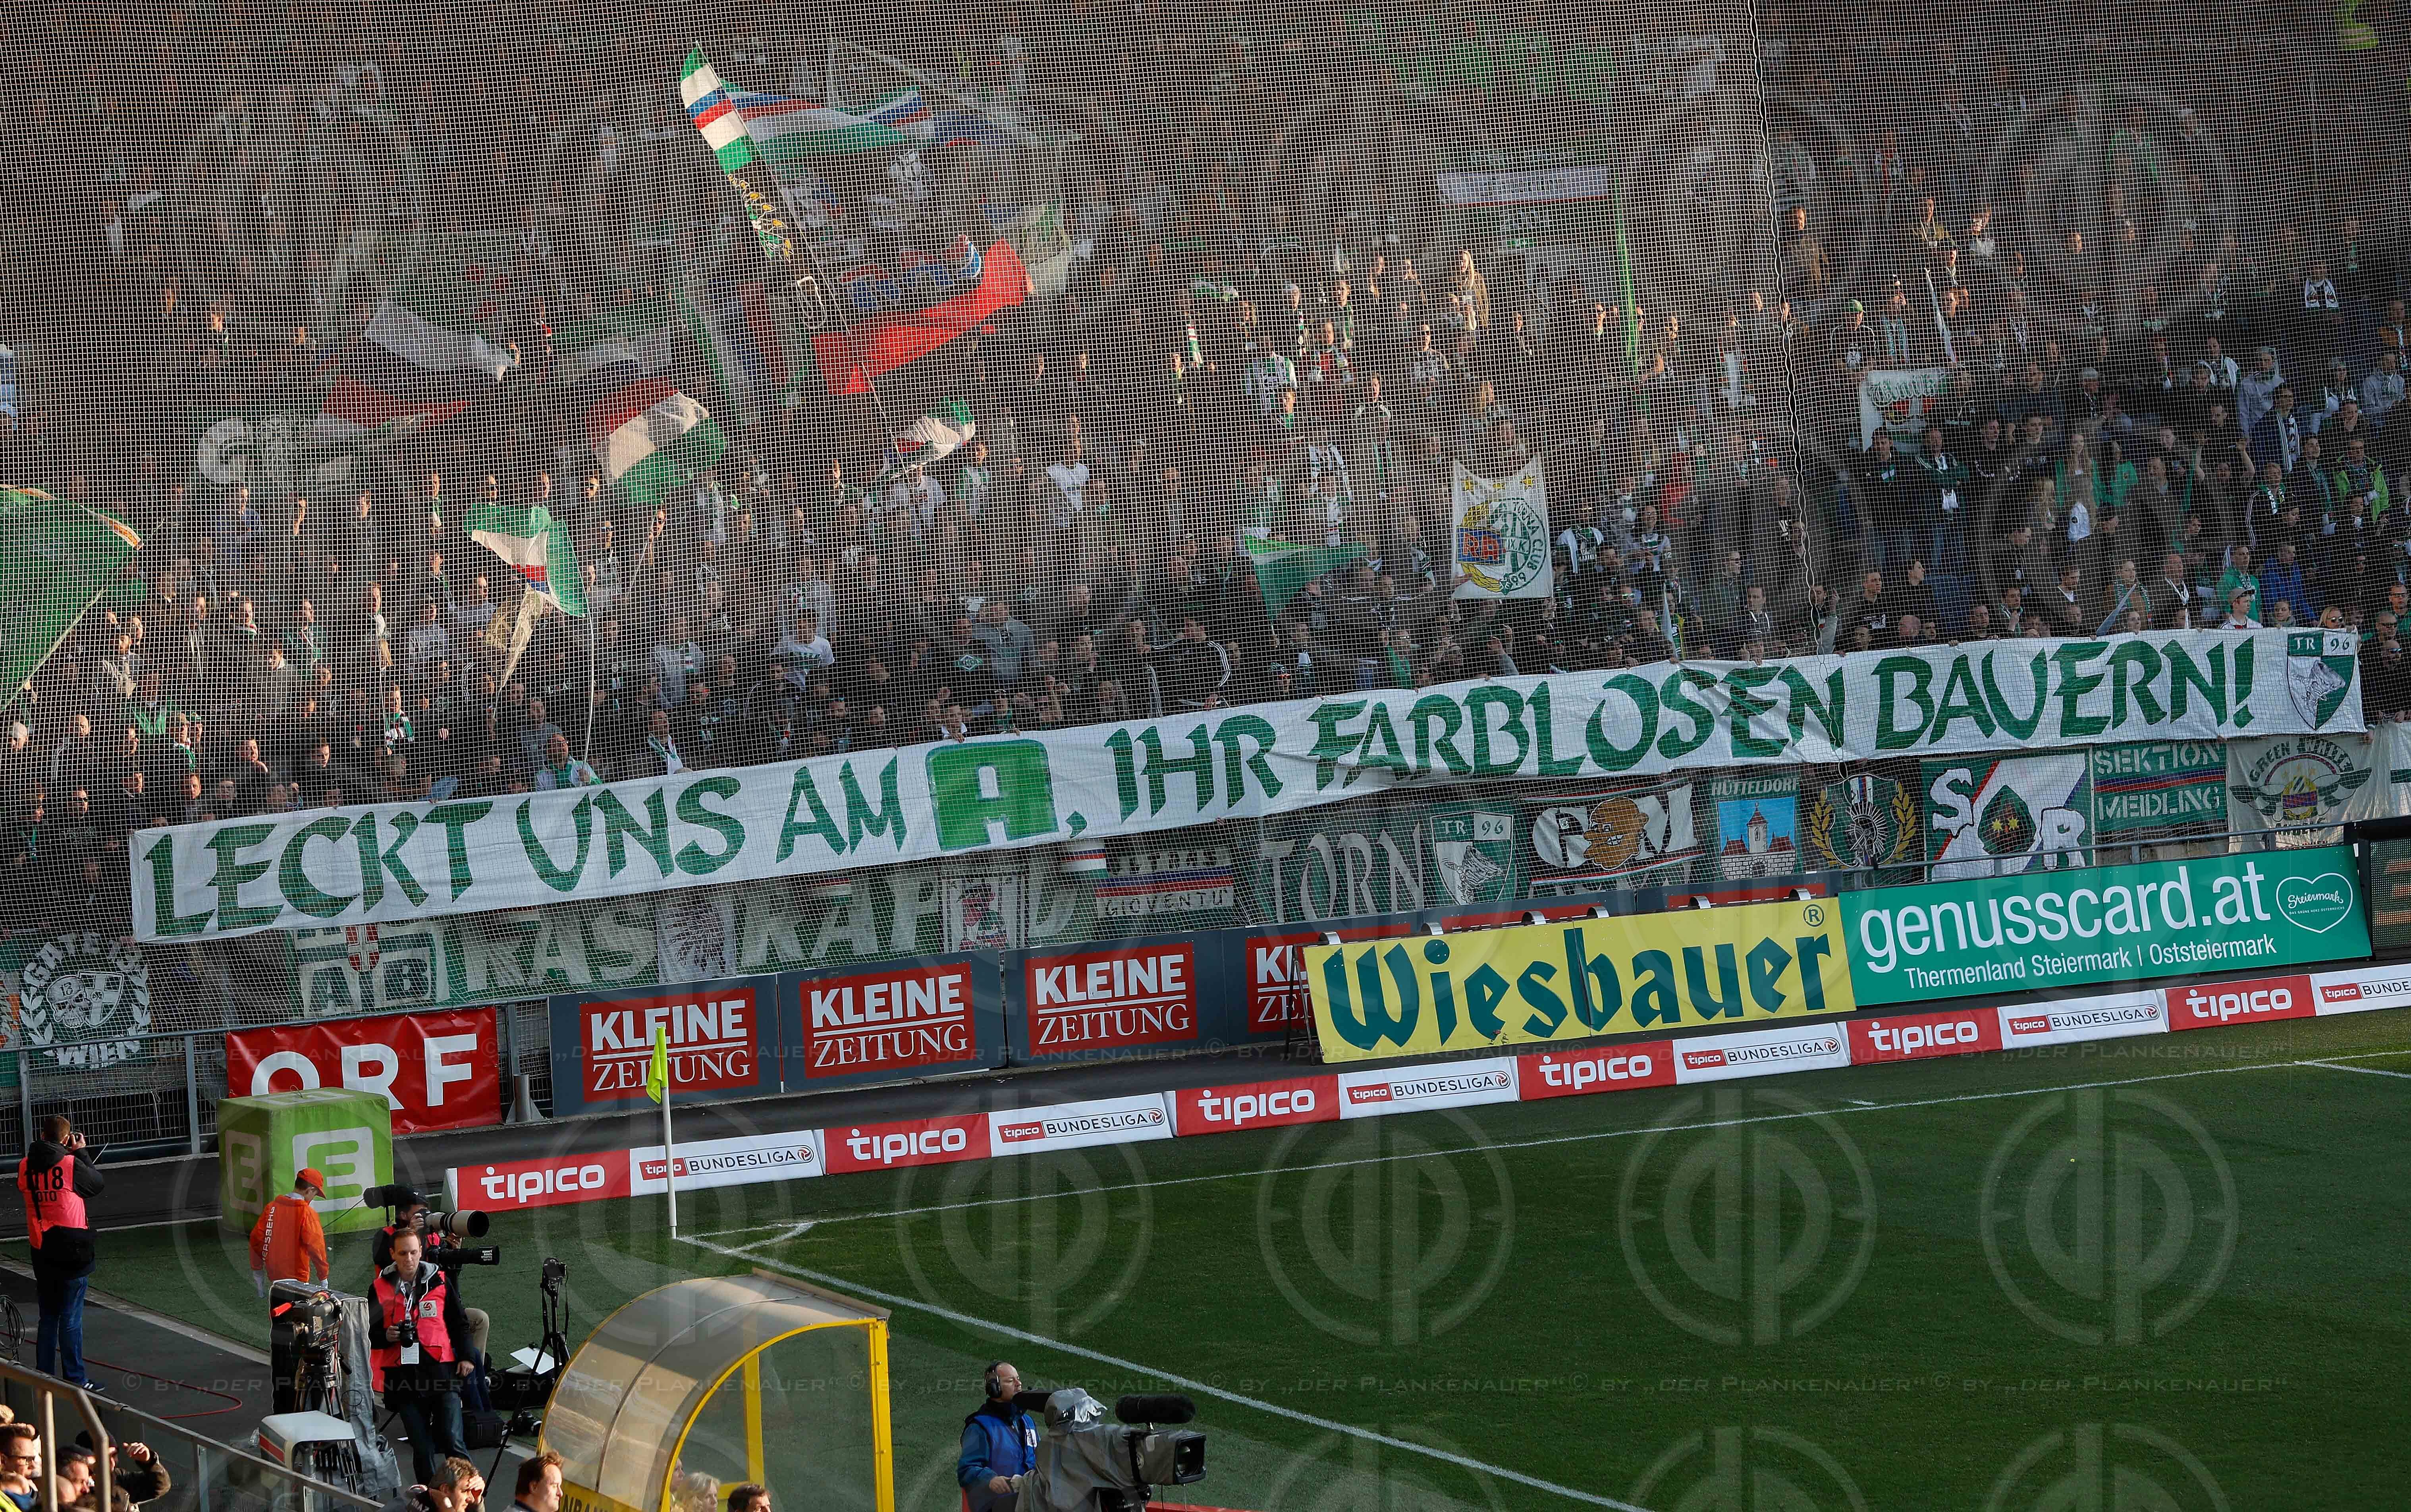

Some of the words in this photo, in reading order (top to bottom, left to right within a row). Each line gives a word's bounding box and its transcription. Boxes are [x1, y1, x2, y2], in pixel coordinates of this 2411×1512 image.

[2293, 638, 2315, 650] TR
[2329, 637, 2351, 652] 96
[2095, 742, 2220, 774] SEKTION
[143, 799, 494, 934] LECKT
[516, 777, 746, 892] UNS
[776, 754, 907, 864] AM
[1106, 715, 1283, 824] IHR
[1307, 664, 1846, 790] FARBLOSEN
[1871, 635, 2255, 750] BAUERN!
[1711, 777, 1800, 796] HÜTTELDORF
[2099, 781, 2221, 820] MEIDLING
[1441, 820, 1466, 835] TR
[1481, 820, 1503, 834] 96
[1860, 861, 2271, 973] genusscard.at
[2288, 890, 2344, 909] Steiermark
[1035, 953, 1186, 1005] KLEINE
[1904, 962, 2025, 989] Thermenland
[2033, 951, 2131, 977] Steiermark
[2149, 934, 2277, 965] Oststeiermark
[810, 974, 964, 1028] KLEINE
[1323, 928, 1831, 1051] Wiesbauer
[2186, 988, 2292, 1022] tipico
[2325, 989, 2357, 999] tipico
[591, 999, 747, 1051] KLEINE
[1038, 1003, 1190, 1045] ZEITUNG
[2013, 1019, 2046, 1031] tipico
[2051, 1008, 2144, 1027] BUNDESLIGA
[814, 1024, 968, 1068] ZEITUNG
[1688, 1053, 1721, 1066] tipico
[1727, 1041, 1824, 1062] BUNDESLIGA
[1868, 1021, 1979, 1055] tipico
[251, 1034, 477, 1110] ORF
[593, 1050, 750, 1091] ZEIUNG
[1353, 1088, 1388, 1100] tipico
[1394, 1076, 1495, 1097] BUNDESLIGA
[1539, 1054, 1652, 1090] tipico
[1198, 1089, 1315, 1125] tipico
[1004, 1126, 1040, 1138] tipico
[1046, 1113, 1148, 1134] BUNDESLIGA
[645, 1163, 682, 1176] tipio
[690, 1150, 797, 1172] BUNDESLIGA
[847, 1128, 967, 1164] tipico
[33, 1190, 58, 1203] OTO
[481, 1165, 605, 1203] tipico
[262, 1206, 276, 1262] ERSBERG
